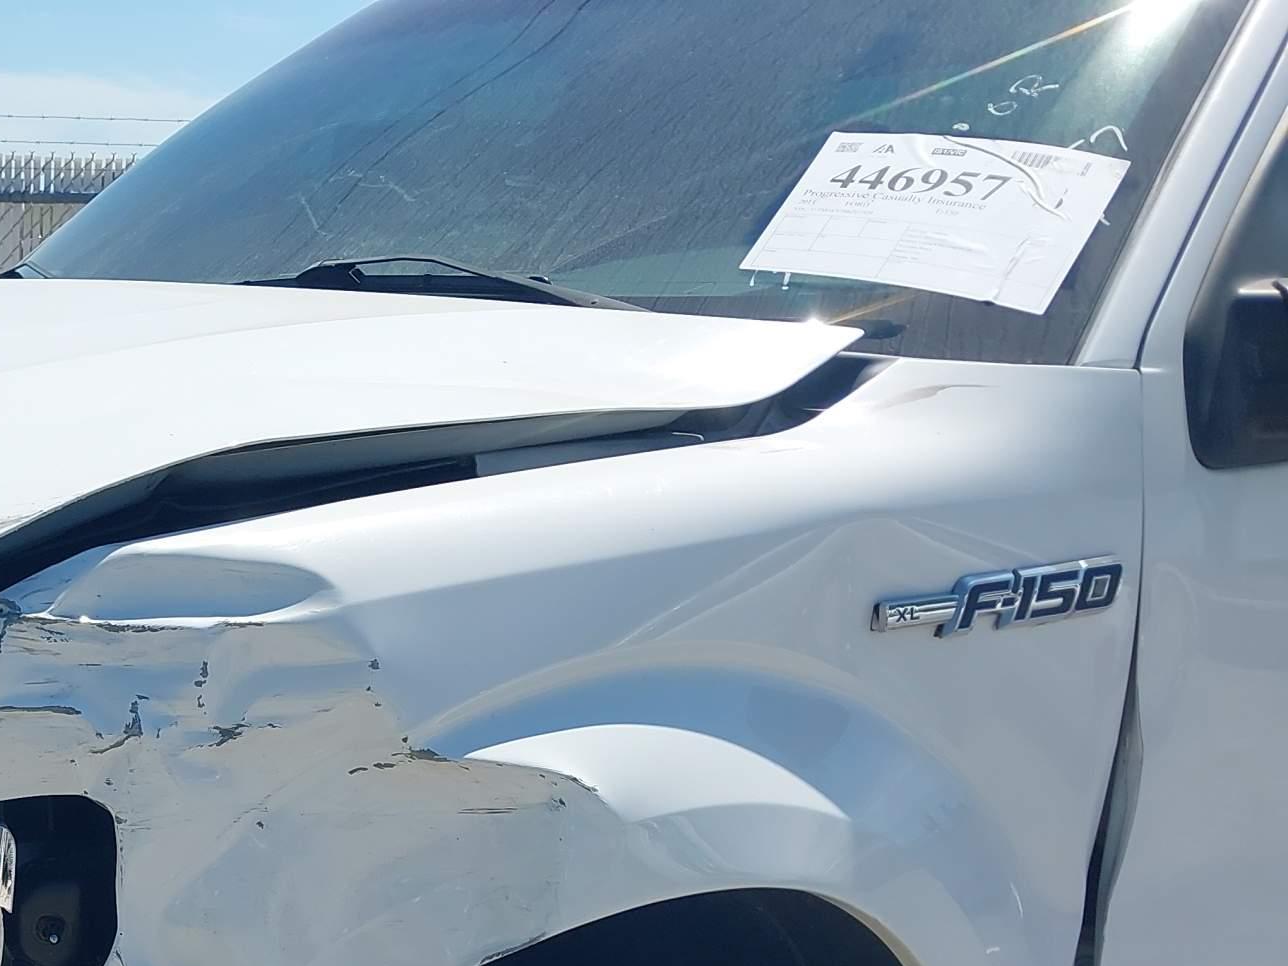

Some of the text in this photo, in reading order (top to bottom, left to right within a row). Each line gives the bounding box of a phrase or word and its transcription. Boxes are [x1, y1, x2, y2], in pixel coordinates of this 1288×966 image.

[829, 163, 1013, 202] 446957
[802, 188, 987, 211] Progressive Casualty Insurance
[895, 605, 921, 623] XL
